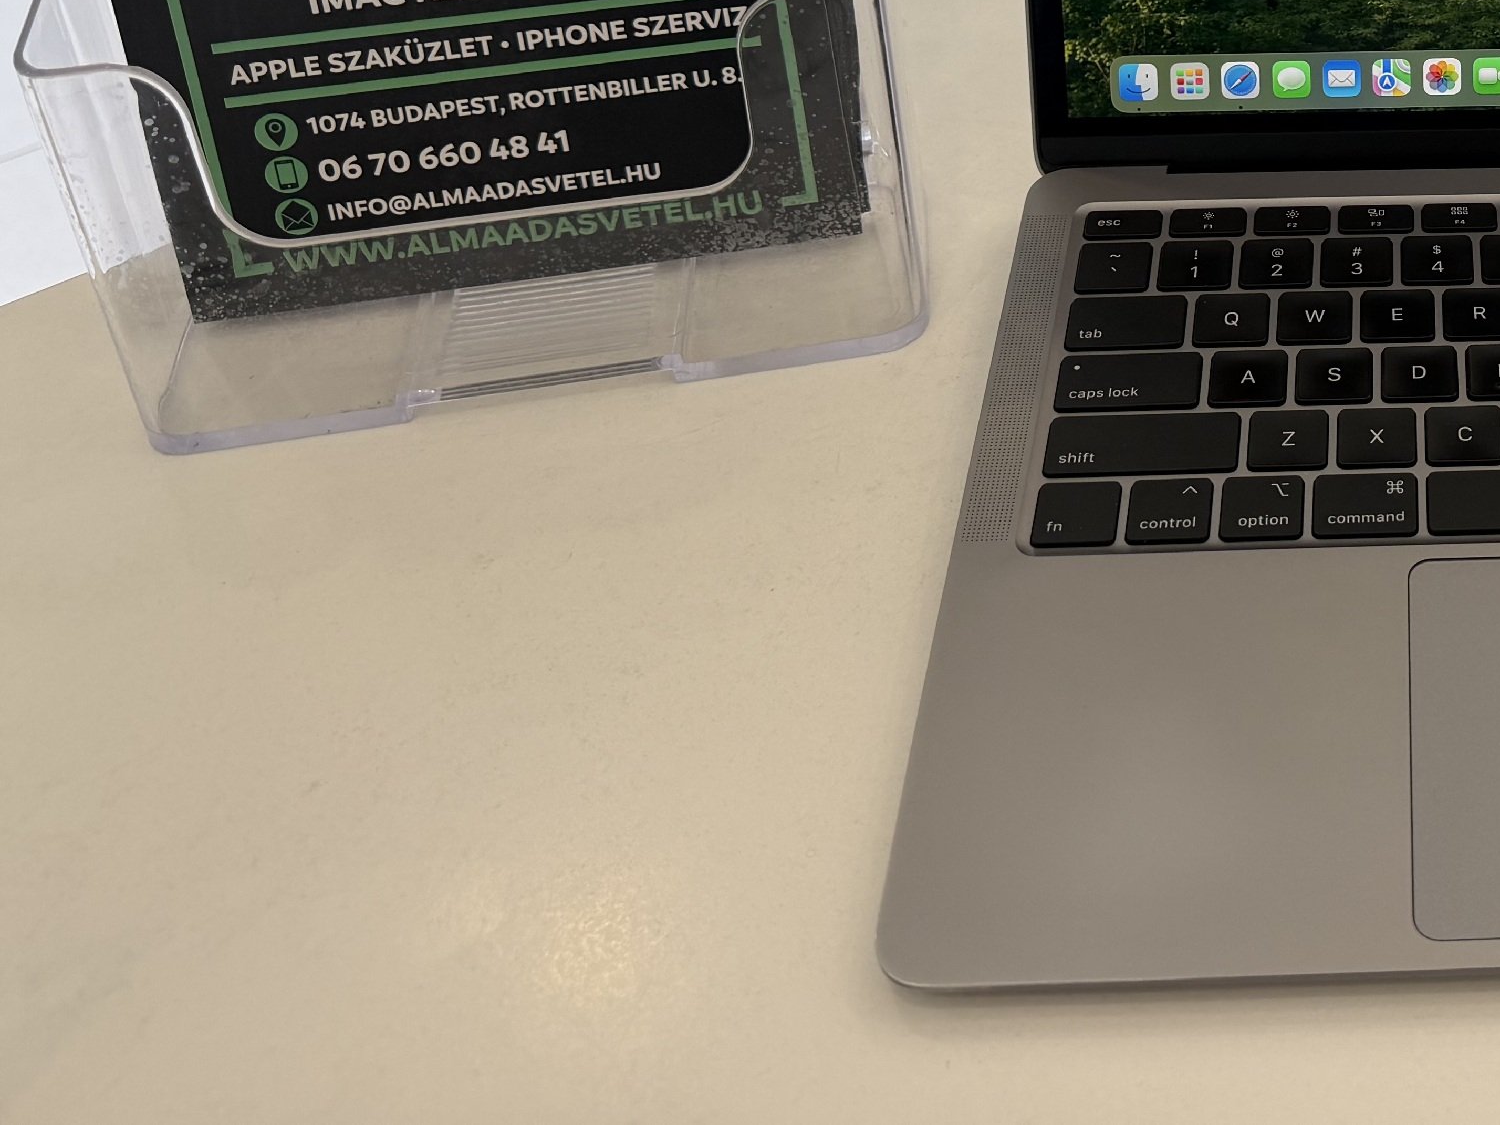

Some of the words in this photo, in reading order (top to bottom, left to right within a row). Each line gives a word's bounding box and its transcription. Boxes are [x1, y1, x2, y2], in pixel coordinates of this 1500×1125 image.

[230, 56, 323, 86] APPLE
[329, 35, 494, 74] SZAKÜZLET
[516, 19, 628, 53] IPHONE
[632, 5, 750, 38] SZERVIZ
[306, 111, 367, 135] 1074
[370, 95, 507, 127] BUDAPEST,
[509, 72, 689, 112] ROTTENBILLER
[691, 69, 718, 88] U.
[318, 153, 363, 182] 06
[367, 149, 411, 177] 70
[418, 140, 483, 171] 660
[489, 134, 531, 161] 48
[536, 129, 571, 155] 41
[327, 162, 662, 222] INFO@ALMAADASVETEL.HU
[1097, 219, 1121, 227] esc
[283, 189, 764, 273] WWW.ALMAADASVETEL.HU
[1190, 265, 1198, 278] 1
[1271, 263, 1283, 277] 2
[1351, 262, 1363, 275] 3
[1431, 260, 1445, 273] 4
[1224, 311, 1239, 327] Q
[1305, 309, 1326, 323] W
[1391, 307, 1404, 321] E
[1473, 306, 1486, 320] R
[1079, 328, 1102, 339] tab
[1240, 369, 1256, 384] A
[1327, 367, 1341, 382] S
[1412, 365, 1427, 380] D
[1068, 390, 1104, 400] caps
[1108, 386, 1139, 398] lock
[1281, 431, 1296, 446] Z
[1369, 428, 1384, 444] X
[1458, 426, 1473, 442] C
[1058, 452, 1095, 464] shift
[1139, 516, 1196, 529] control
[1238, 514, 1289, 528] option
[1327, 510, 1405, 524] command
[1046, 521, 1063, 532] fn
